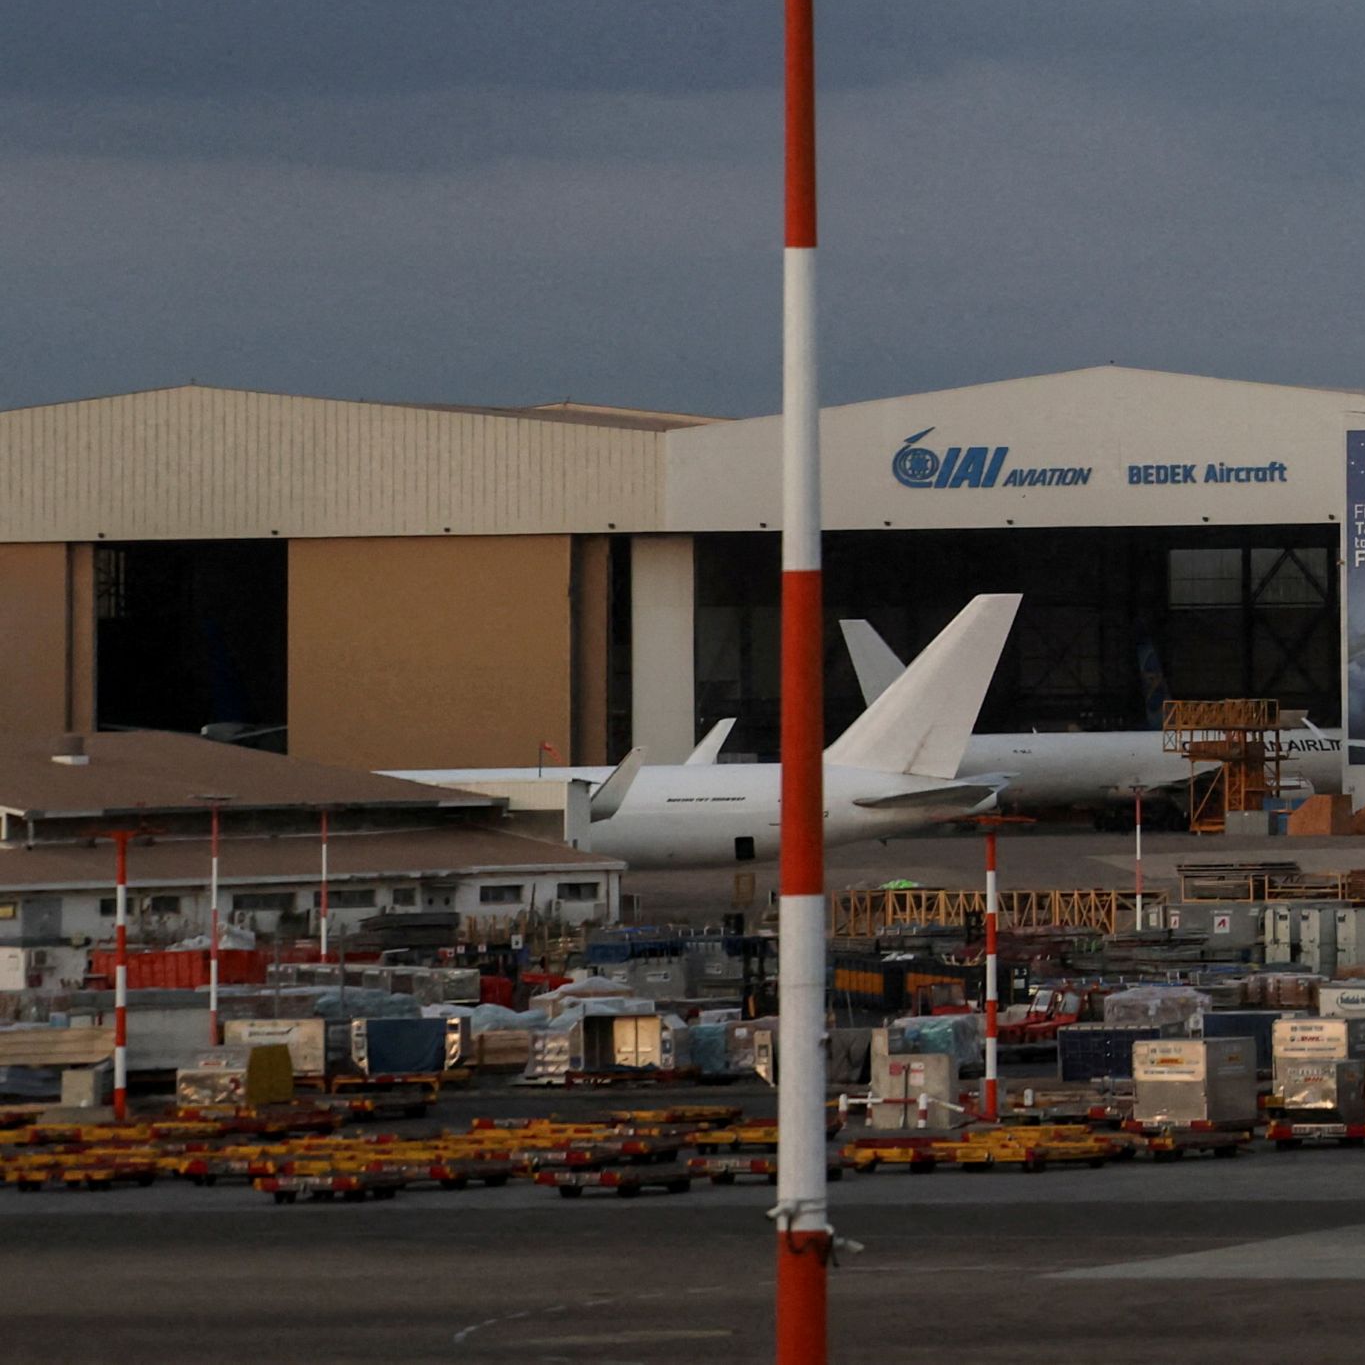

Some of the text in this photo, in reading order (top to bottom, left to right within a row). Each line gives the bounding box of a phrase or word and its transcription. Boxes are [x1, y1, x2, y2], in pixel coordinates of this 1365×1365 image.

[934, 446, 1092, 488] IAI AVIATION
[1128, 461, 1288, 485] BEDEK Aircraft
